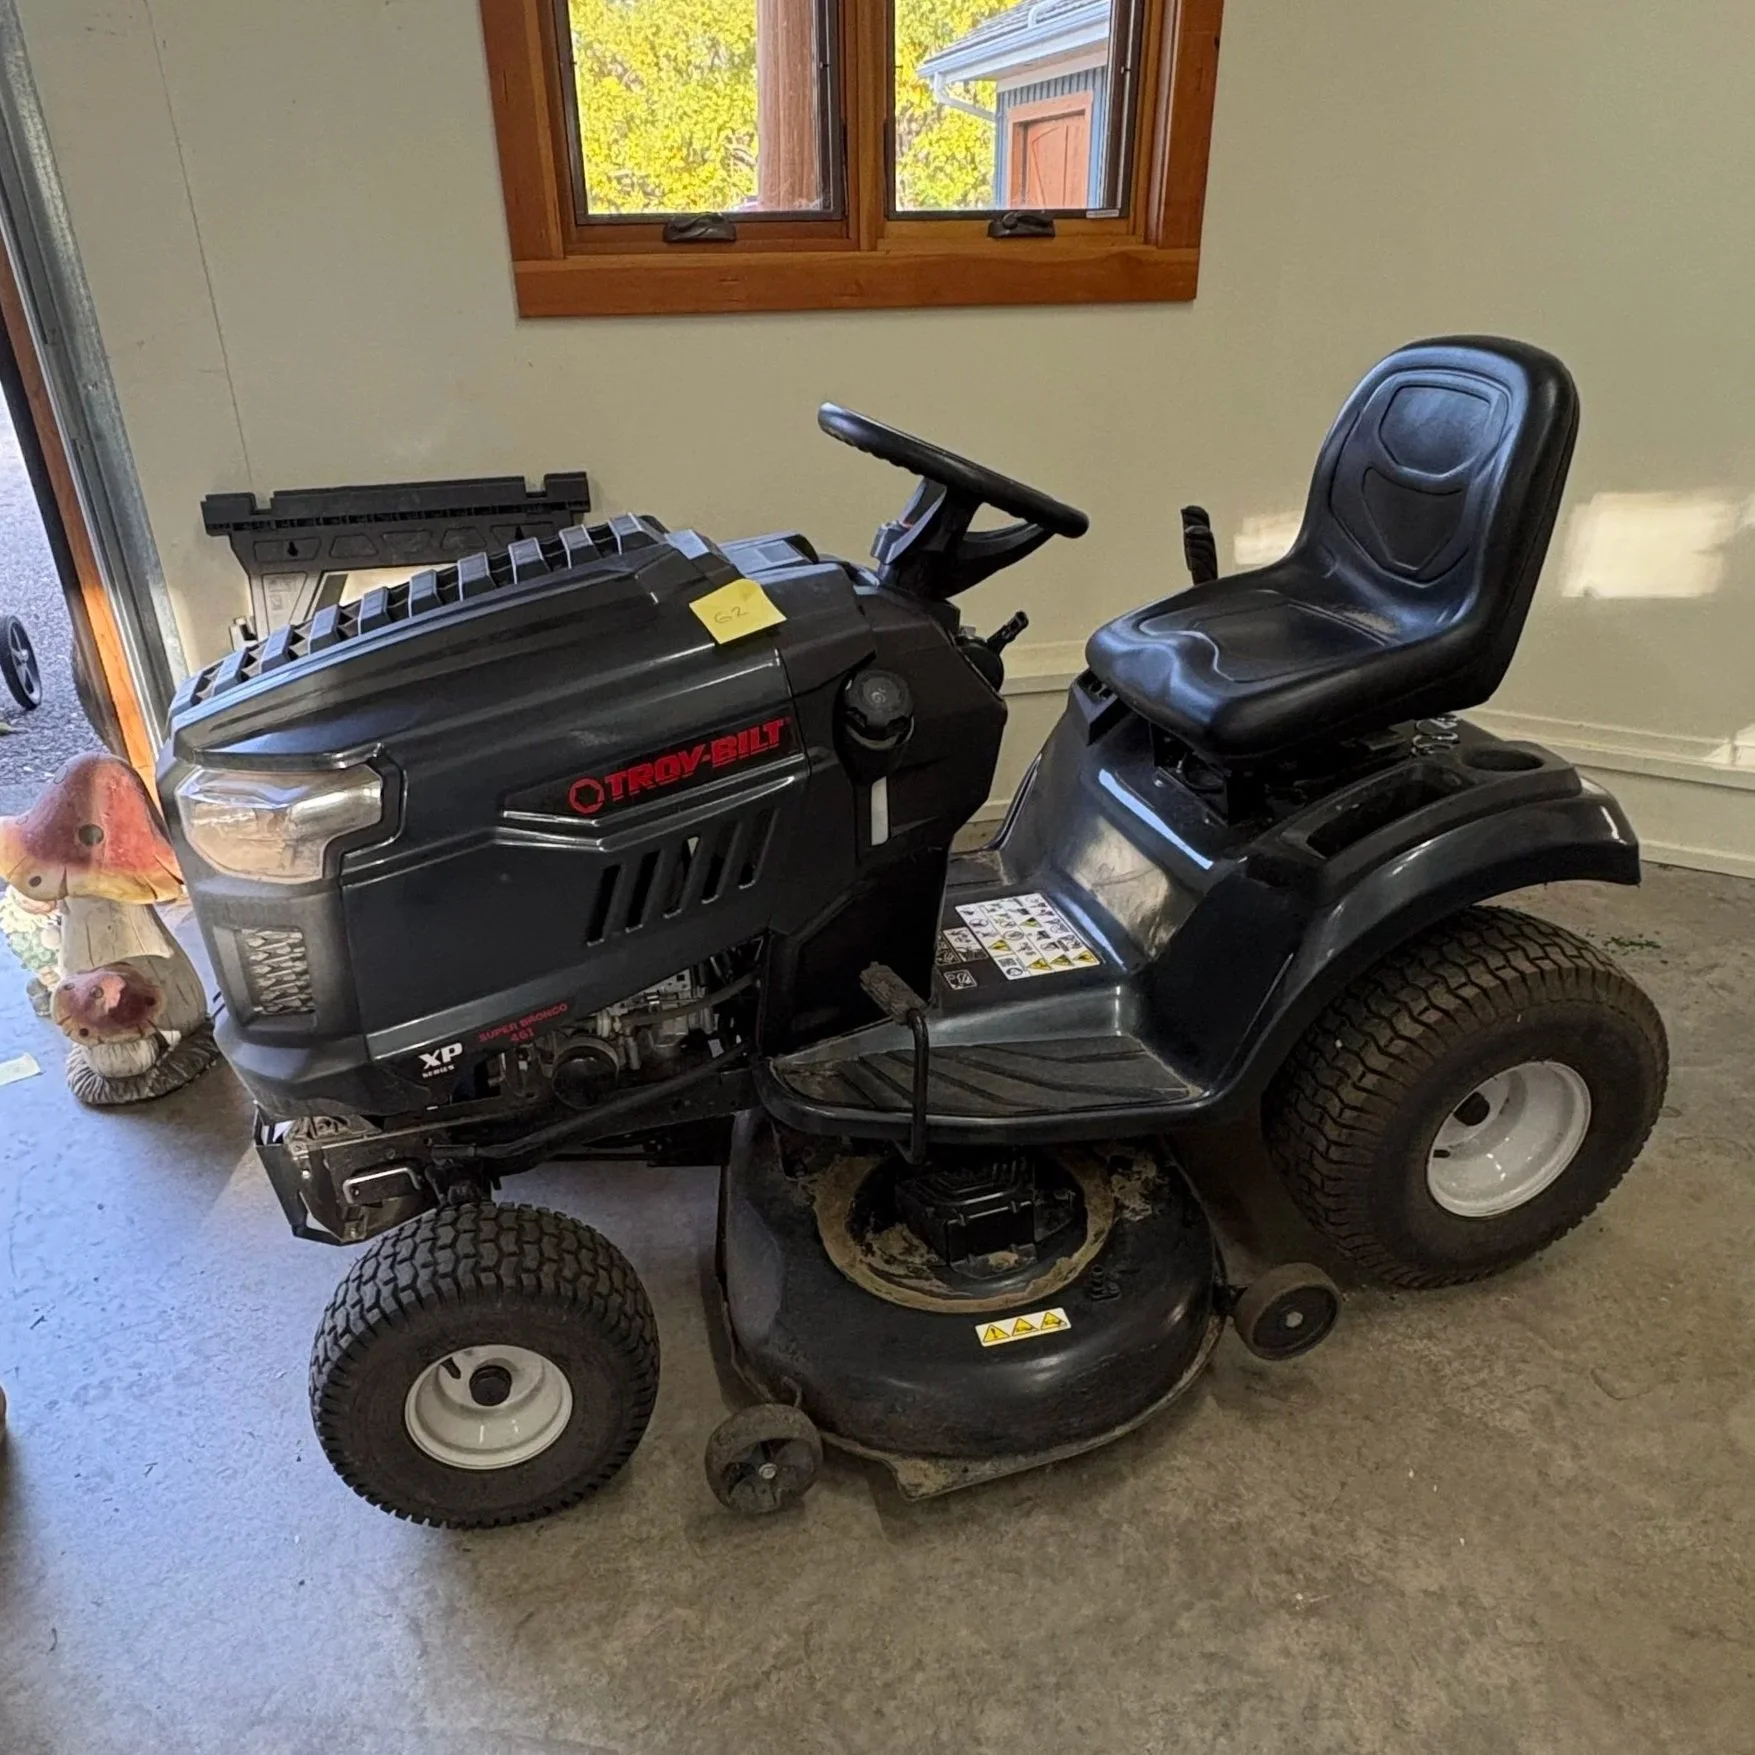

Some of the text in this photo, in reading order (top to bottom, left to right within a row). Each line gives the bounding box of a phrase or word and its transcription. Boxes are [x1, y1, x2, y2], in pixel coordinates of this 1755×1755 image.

[604, 719, 785, 801] TROY-BILT
[479, 1002, 568, 1043] SUPER BRONCO
[418, 1042, 463, 1070] XP
[422, 1064, 455, 1079] SERIES
